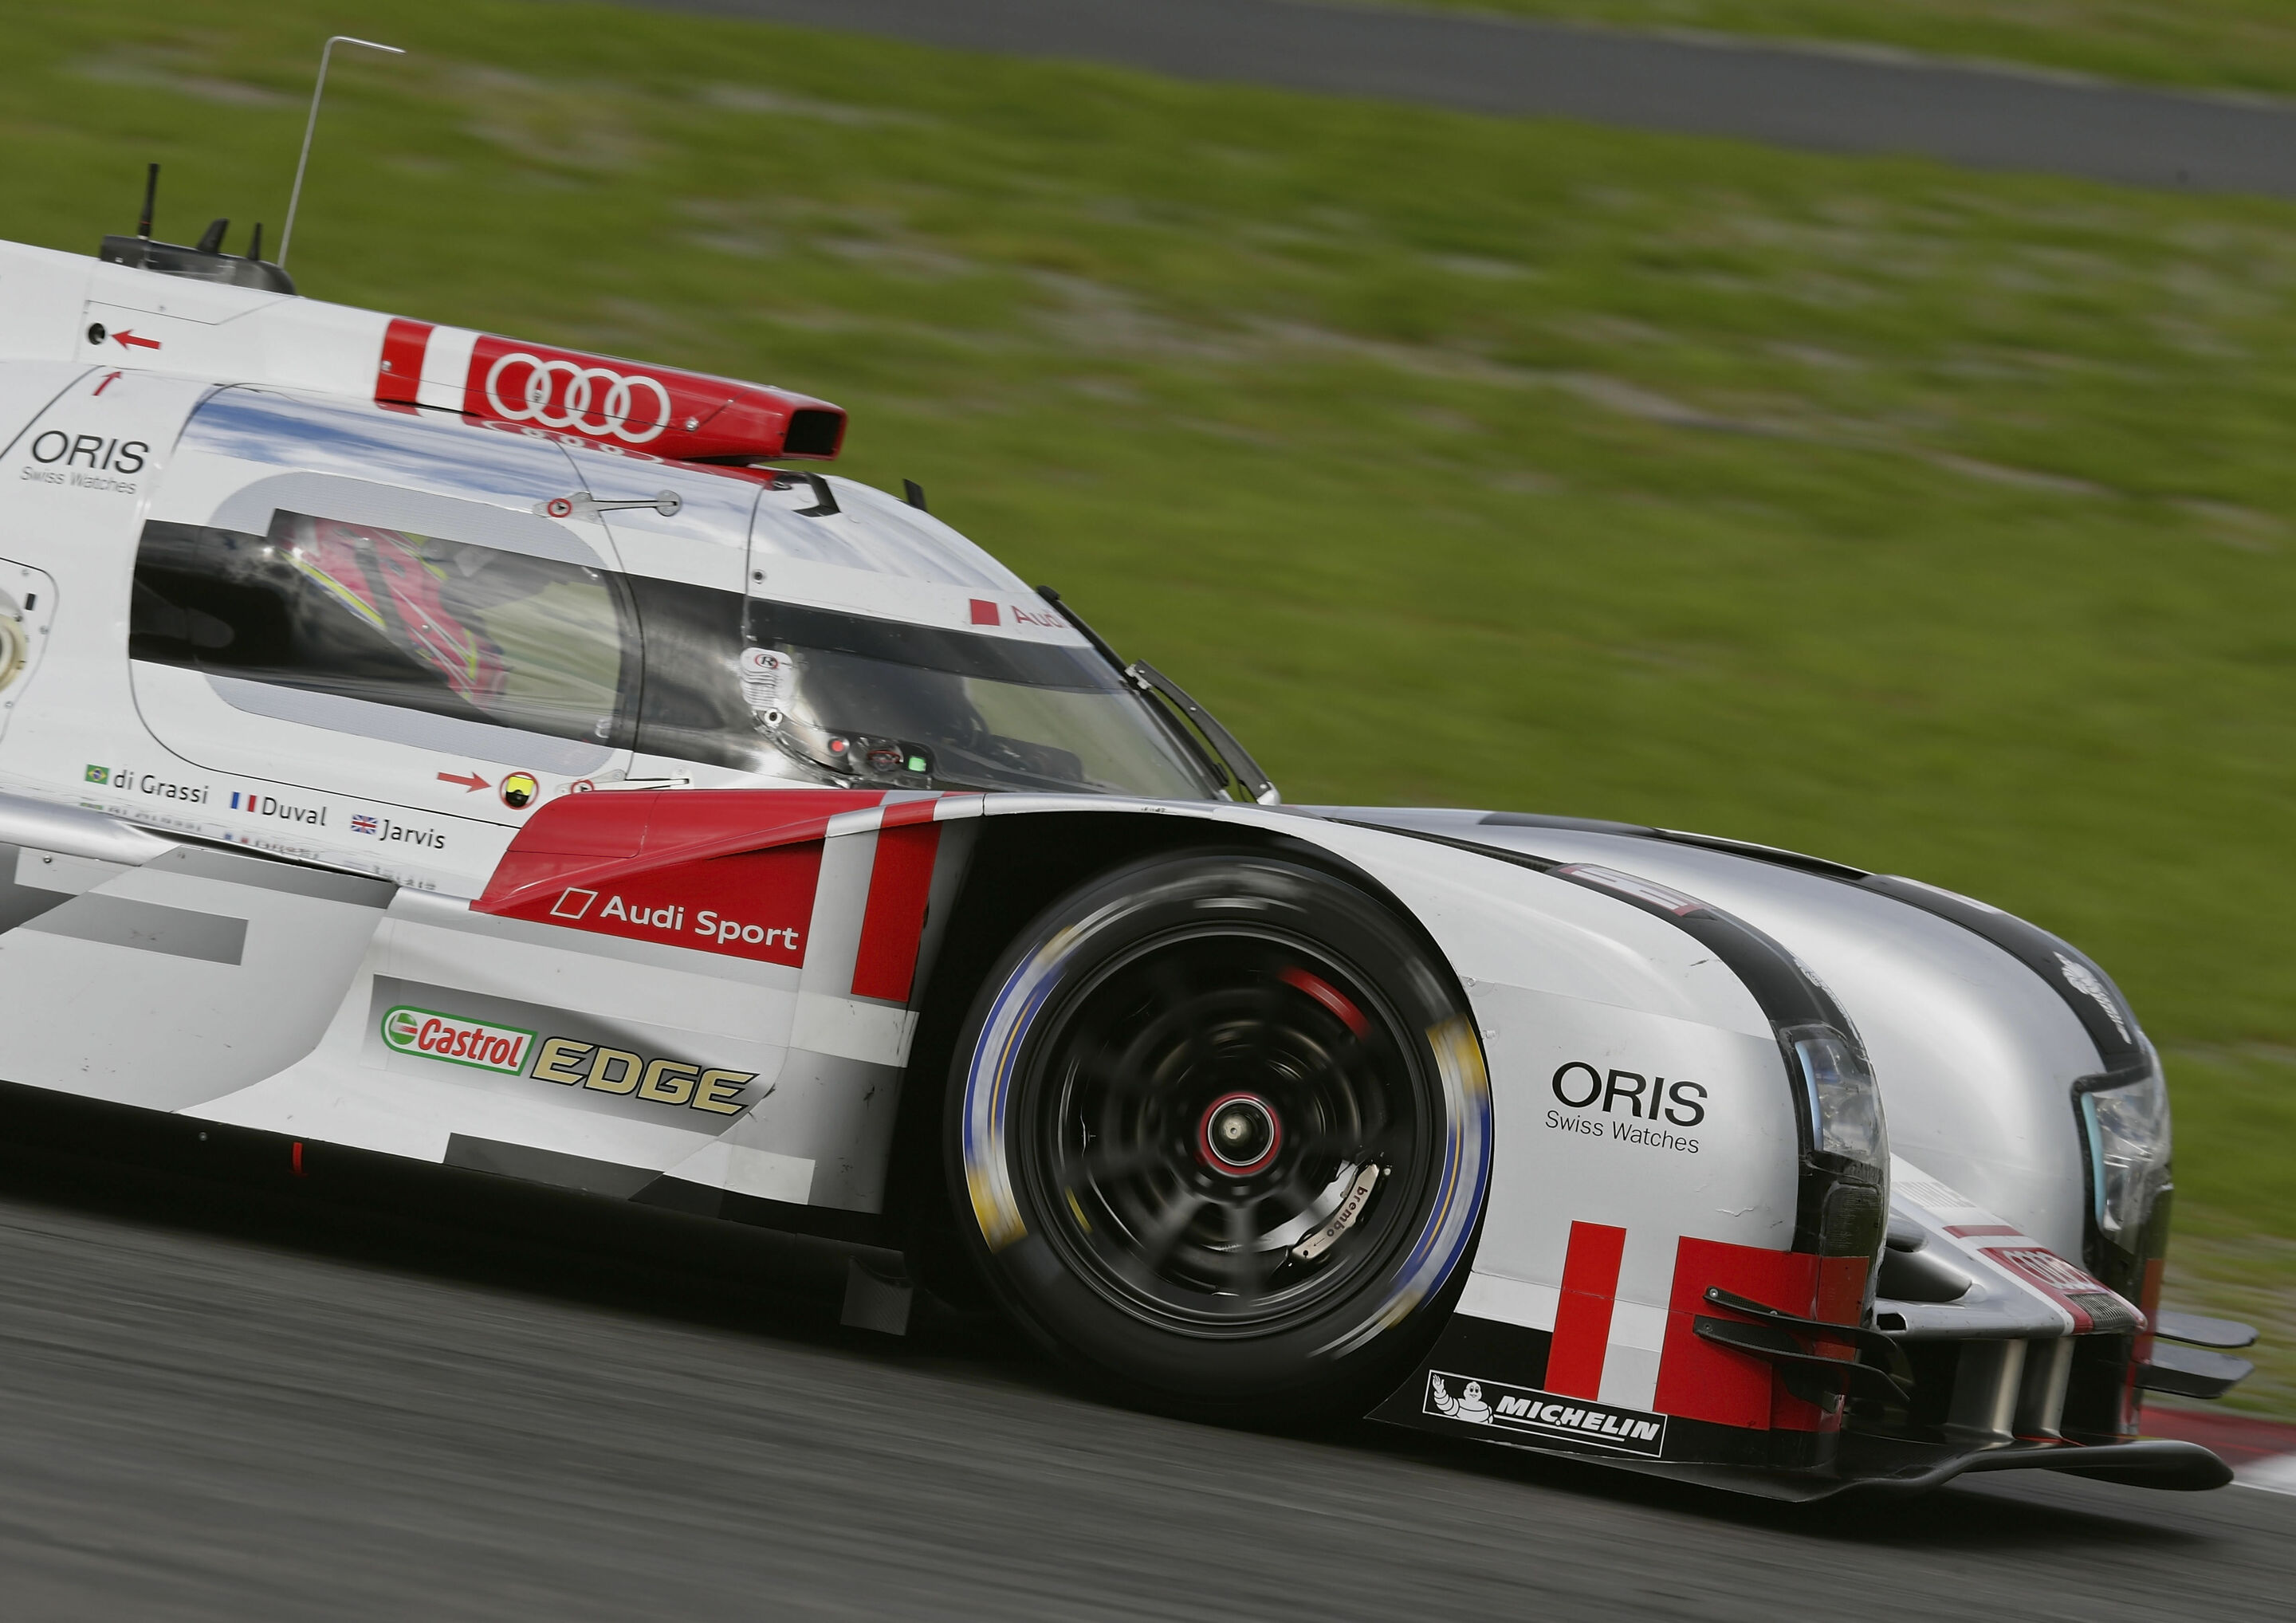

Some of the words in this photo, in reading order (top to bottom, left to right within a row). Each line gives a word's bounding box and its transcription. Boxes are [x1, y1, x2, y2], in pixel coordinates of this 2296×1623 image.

[32, 430, 150, 474] ORIS
[20, 466, 65, 485] Swiss
[69, 471, 137, 495] Watches
[114, 768, 134, 790] di
[140, 774, 209, 804] Grassi
[261, 796, 327, 827] Duval
[379, 819, 446, 850] Jarvis
[600, 895, 684, 931] Audi
[694, 910, 800, 950] Sport
[418, 1017, 522, 1068] Castrol
[529, 1036, 761, 1116] EDGE
[1551, 1061, 1708, 1127] ORIS
[1545, 1110, 1604, 1137] Swiss
[1612, 1121, 1700, 1153] Watches
[1326, 1185, 1369, 1237] brembo
[1495, 1395, 1661, 1441] MICHELIN
